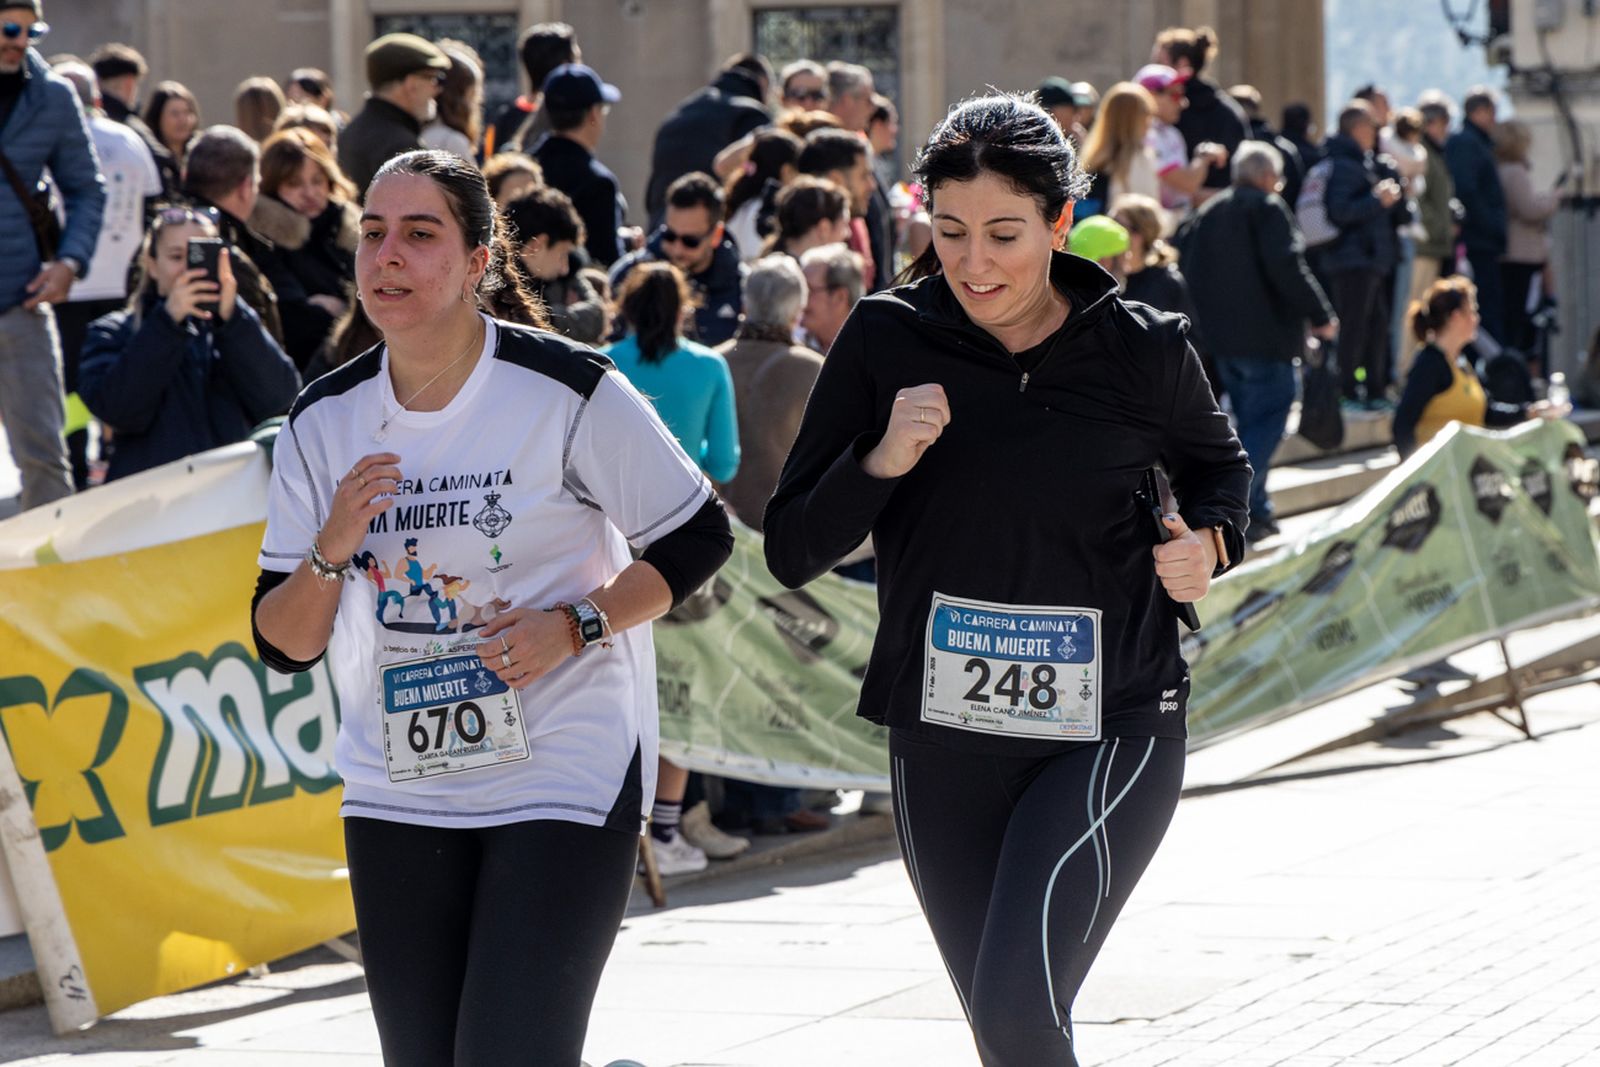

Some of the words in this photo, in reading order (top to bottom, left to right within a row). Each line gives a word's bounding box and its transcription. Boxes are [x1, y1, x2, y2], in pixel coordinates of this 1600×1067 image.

[429, 469, 513, 492] CAMINATA
[395, 500, 470, 532] MUERTE
[963, 613, 1017, 631] CARRERA
[1019, 619, 1078, 633] CAMINATA
[448, 643, 478, 653] ASPERG
[947, 629, 991, 652] BUENA
[995, 636, 1051, 657] MUERTE
[400, 667, 433, 683] CARRERA
[434, 658, 485, 677] CAMINAT
[962, 657, 1058, 710] 248
[394, 686, 422, 707] BUENA
[422, 678, 469, 702] MUERTE
[970, 704, 992, 714] ELENA
[136, 646, 341, 822] ma
[408, 701, 487, 753] 670
